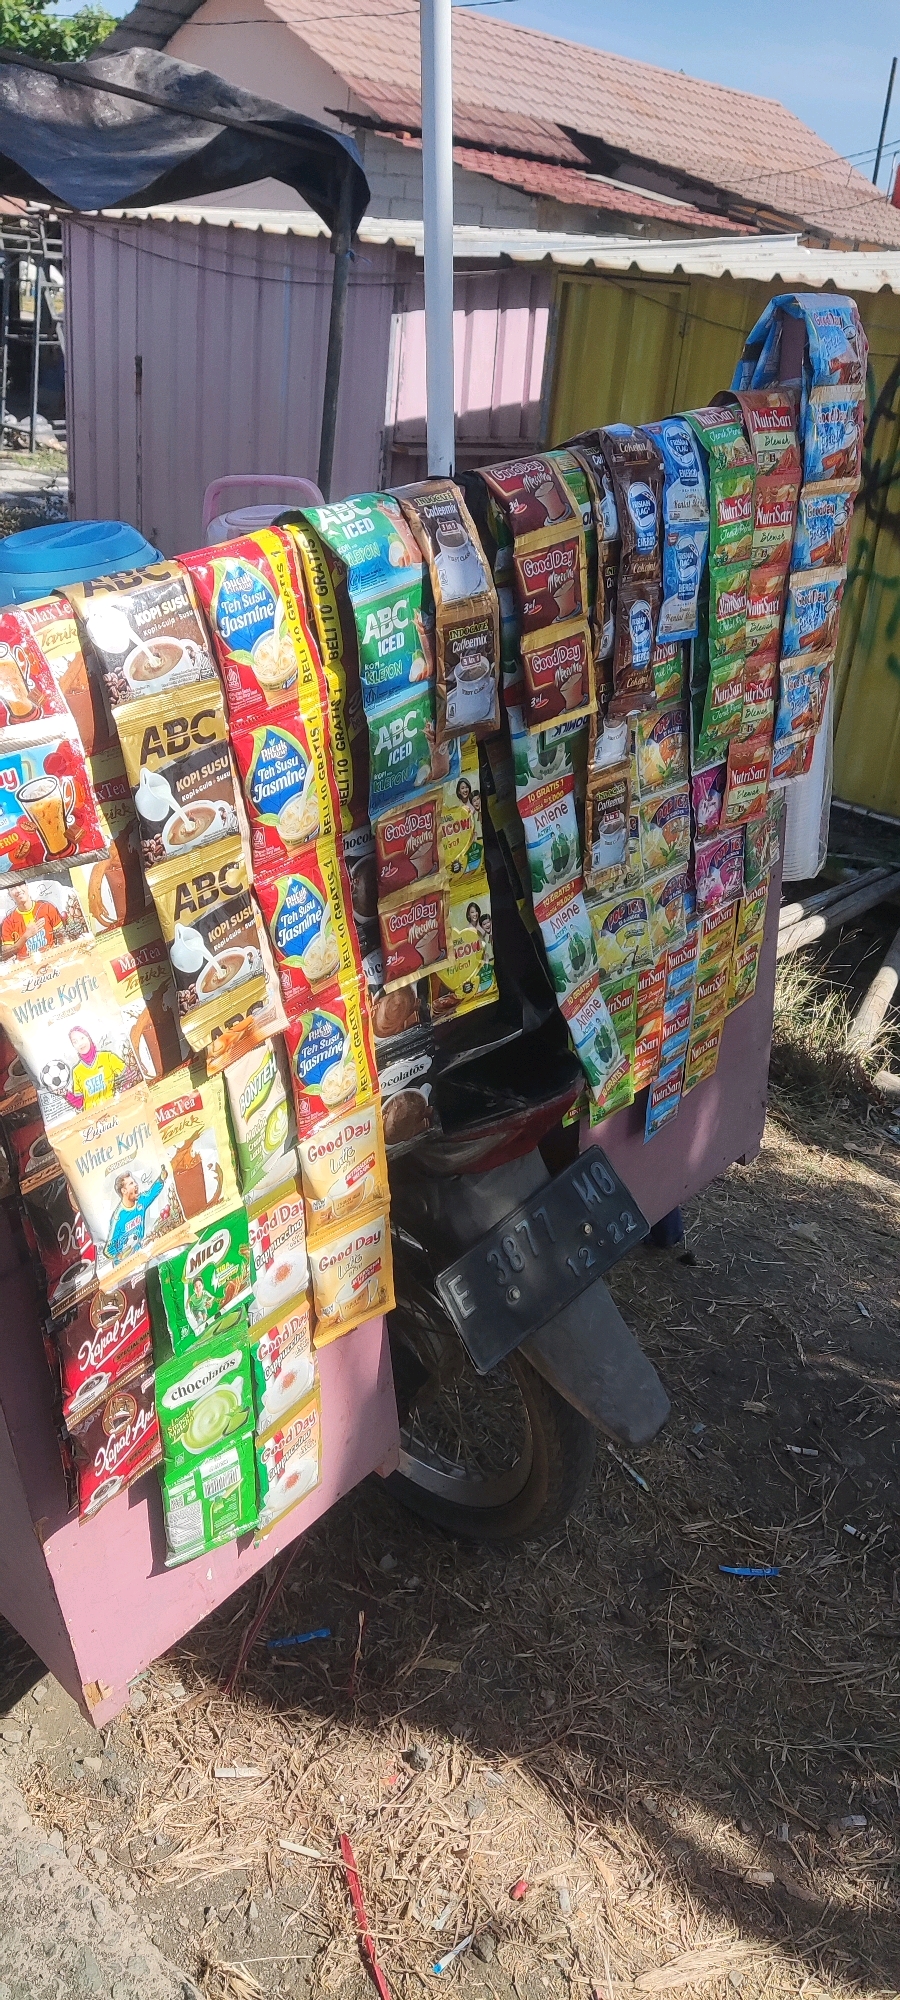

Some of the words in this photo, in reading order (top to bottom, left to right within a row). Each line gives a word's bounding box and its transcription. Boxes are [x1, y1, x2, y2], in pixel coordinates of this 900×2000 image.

[752, 408, 792, 430] NutriSari
[315, 498, 372, 532] ABC
[424, 502, 458, 519] Coffeemix
[756, 505, 793, 526] NutriSari
[342, 517, 375, 540] ICED
[271, 549, 281, 558] 1
[303, 537, 328, 597] GRATIS
[523, 552, 553, 577] Good
[552, 549, 574, 569] Day
[82, 562, 172, 599] ABC
[276, 562, 297, 621] GRATIS
[133, 606, 163, 628] KOPI
[162, 593, 190, 616] SUSU
[221, 596, 242, 615] Teh
[241, 589, 267, 608] Susu
[320, 604, 333, 622] 10
[221, 598, 276, 638] Jasmine
[362, 598, 410, 645] ABC
[449, 619, 489, 641] INDOCAFE
[294, 626, 302, 644] 10
[322, 626, 340, 661] BELI
[378, 632, 405, 657] ICED
[452, 633, 488, 654] Coffeemix
[299, 649, 314, 685] BELI
[364, 659, 403, 686] KLEPON
[532, 649, 560, 673] Good
[557, 644, 580, 663] Day
[308, 714, 318, 724] 1
[330, 697, 347, 753] GRATIS
[373, 709, 418, 756] ABC
[140, 708, 218, 767] ABC
[310, 727, 326, 783] GRATIS
[337, 757, 349, 776] 10
[387, 740, 413, 767] ICED
[175, 770, 202, 793] KOPI
[202, 755, 229, 779] SUSU
[253, 763, 307, 804] Jasmine
[257, 766, 276, 783] Teh
[275, 755, 299, 774] Susu
[731, 767, 767, 786] NutriSari
[322, 784, 330, 801] 10
[527, 793, 536, 803] 10
[535, 781, 560, 799] GRATIS
[322, 806, 333, 836] BELI
[385, 816, 410, 842] Good
[410, 812, 433, 831] Day
[534, 802, 569, 832] Anlene
[323, 858, 333, 868] 1
[174, 861, 245, 921] ABC
[327, 871, 344, 920] GRATIS
[542, 899, 550, 908] 10
[550, 885, 571, 902] GRATIS
[277, 907, 323, 948] Jasmine
[280, 912, 299, 928] Teh
[298, 899, 316, 917] Susu
[389, 906, 415, 932] Good
[415, 901, 437, 919] Day
[549, 903, 581, 935] Anlene
[704, 907, 732, 933] NutriSari
[207, 923, 232, 944] KOPI
[338, 924, 345, 939] 10
[119, 946, 162, 973] MaxTea
[340, 943, 353, 969] BELI
[668, 946, 699, 971] NutriSari
[21, 968, 61, 994] Luwak
[567, 995, 573, 1004] 10
[572, 980, 590, 999] GRATIS
[12, 995, 56, 1025] White
[56, 973, 100, 1007] Koffie
[348, 994, 356, 1002] 1
[347, 1004, 362, 1048] GRATIS
[575, 997, 602, 1031] Anlene
[662, 1015, 691, 1040] NutriSari
[298, 1037, 344, 1077] Jasmine
[301, 1044, 319, 1059] Teh
[318, 1032, 340, 1051] Susu
[357, 1050, 364, 1065] 10
[691, 1034, 718, 1062] NutriSari
[239, 1056, 278, 1118] BONTEH
[360, 1065, 369, 1092] BELI
[601, 1087, 608, 1098] 10
[607, 1069, 623, 1092] GRATIS
[652, 1079, 682, 1105] NutriSari
[155, 1097, 196, 1124] MaxTea
[82, 1114, 119, 1144] Luwak
[245, 1117, 268, 1144] Matcha
[248, 1130, 266, 1152] Creamy
[308, 1130, 343, 1162] Good
[343, 1119, 371, 1145] Day
[75, 1145, 115, 1178] White
[249, 1213, 278, 1248] Good
[255, 1218, 304, 1270] Cappuccino
[189, 1238, 225, 1274] MILO
[319, 1243, 353, 1272] Good
[355, 1229, 382, 1251] Day
[447, 1274, 477, 1320] E
[486, 1206, 556, 1286] 3877
[78, 1320, 120, 1371] Kapal
[120, 1299, 146, 1338] Api
[258, 1327, 290, 1361] Good
[290, 1311, 310, 1337] Day
[265, 1326, 307, 1380] Cappuccino
[171, 1358, 236, 1401] chocolatos
[94, 1425, 132, 1477] Kapal
[131, 1401, 155, 1441] Api
[262, 1429, 293, 1463] Good
[293, 1410, 316, 1437] Day
[269, 1429, 312, 1482] Cappuccino
